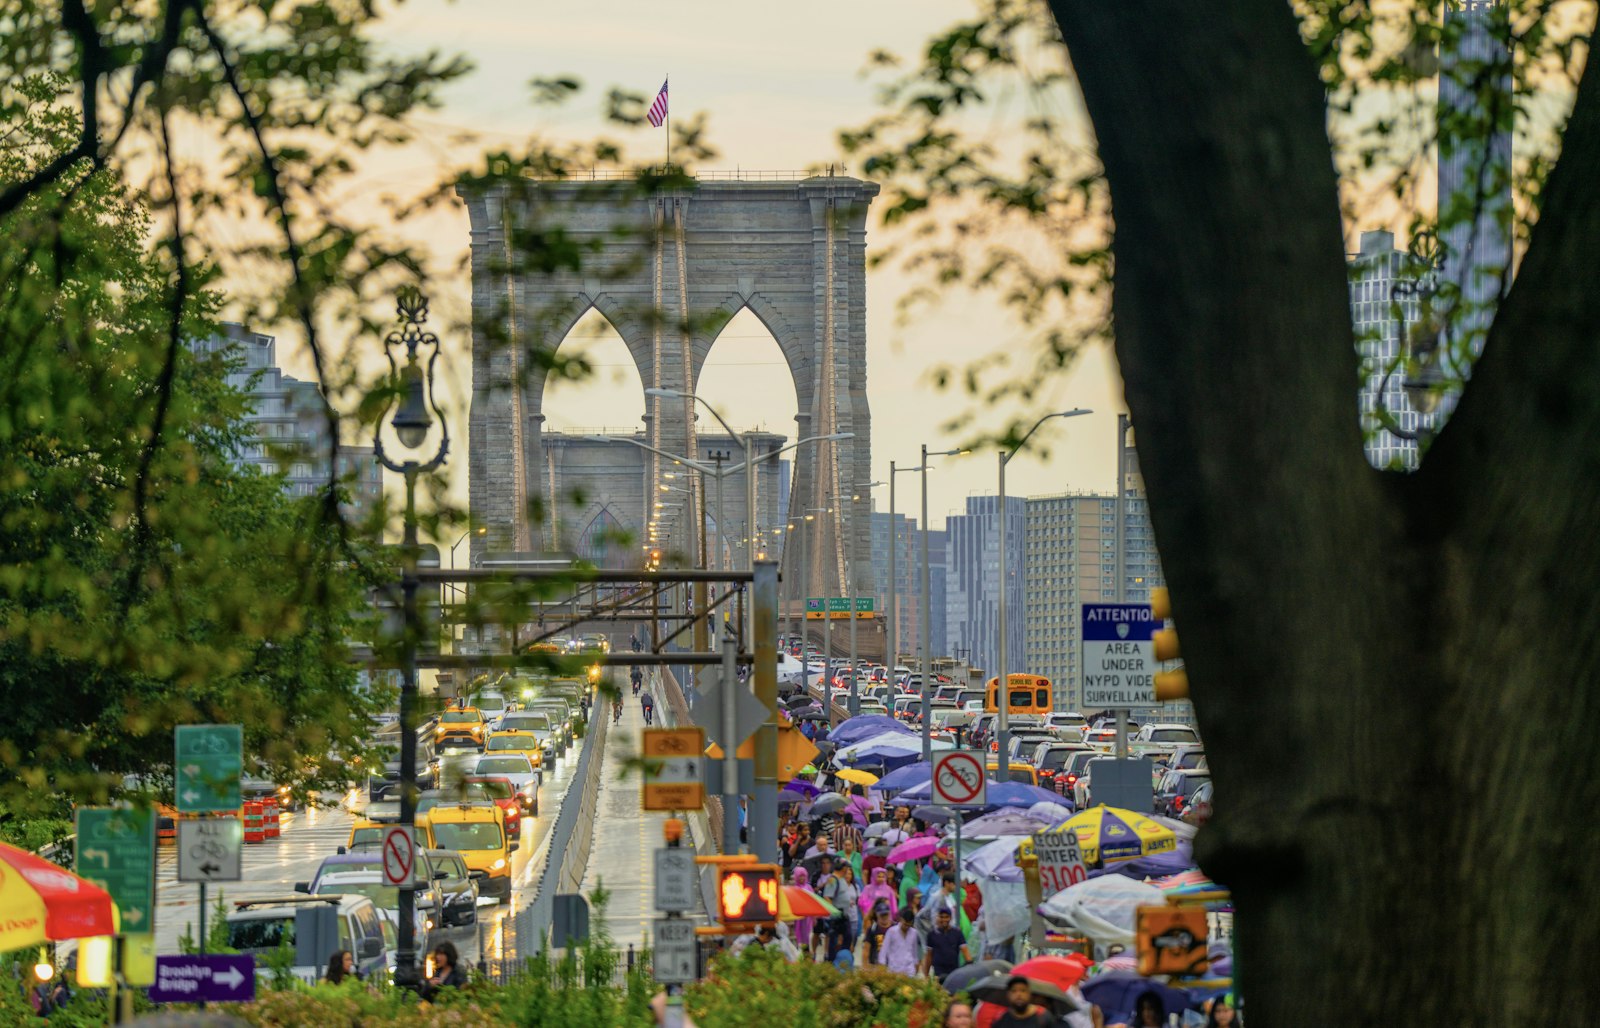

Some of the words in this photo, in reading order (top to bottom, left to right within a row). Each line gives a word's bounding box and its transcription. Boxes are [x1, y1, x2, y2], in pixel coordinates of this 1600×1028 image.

[1105, 643, 1140, 654] AREA
[1102, 659, 1144, 670] UNDER
[1086, 675, 1120, 686] NYPD
[1126, 675, 1152, 686] VIDE
[1086, 690, 1155, 702] SURVEILLANC
[197, 823, 219, 835] ALL
[1045, 832, 1077, 847] COLD
[758, 878, 778, 915] 4
[159, 964, 212, 980] Brooklyn
[158, 977, 198, 994] Bridge
